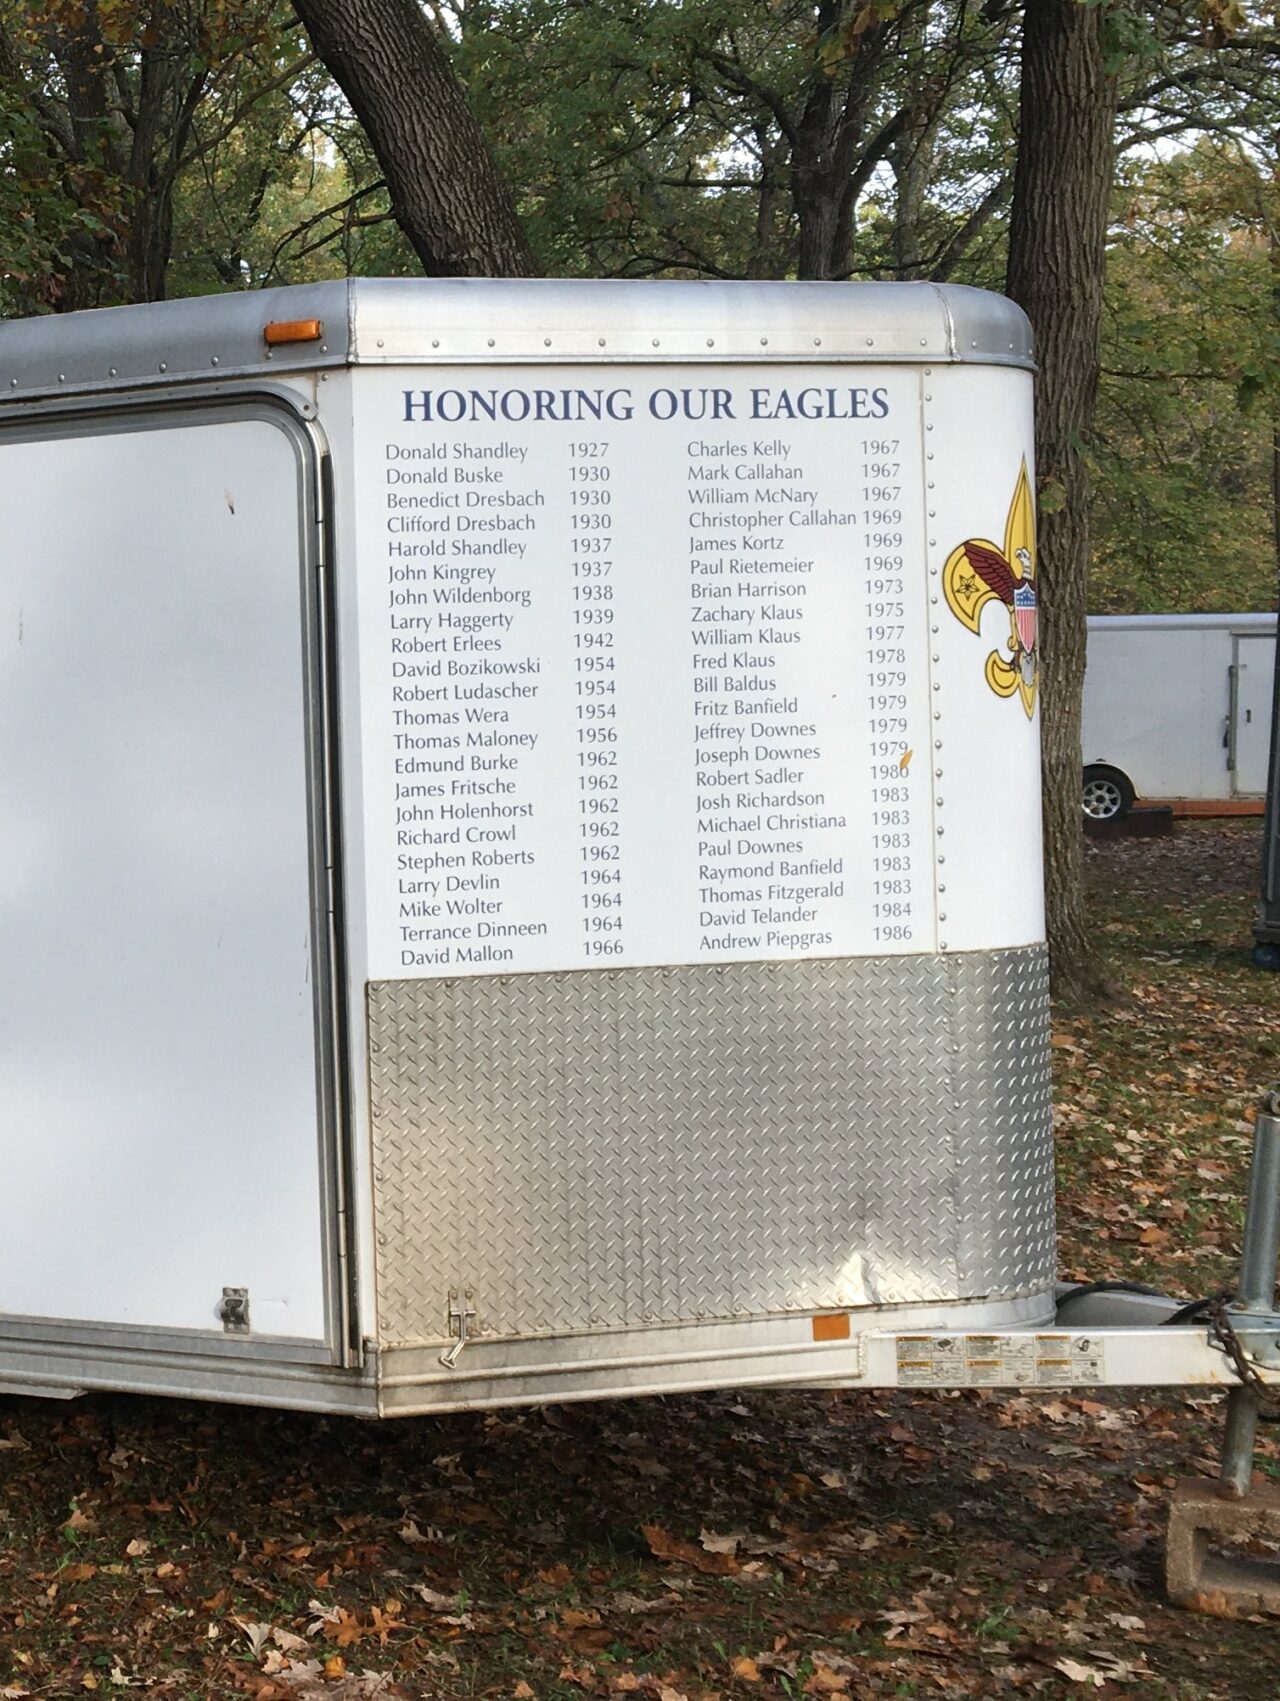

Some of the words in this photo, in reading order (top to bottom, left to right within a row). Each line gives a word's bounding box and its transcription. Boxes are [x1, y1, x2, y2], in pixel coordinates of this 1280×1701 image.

[401, 388, 635, 422] HONORING
[648, 388, 737, 421] OUR
[749, 387, 889, 420] EAGLES
[385, 442, 447, 461] Donald
[452, 441, 529, 464] Shandley
[568, 442, 610, 458] 1927
[687, 440, 748, 458] Charles
[753, 439, 791, 461] Kelly
[861, 439, 900, 455] 1967
[386, 466, 448, 485] Donald
[454, 465, 504, 484] Buske
[569, 465, 611, 482] 1930
[687, 463, 730, 481] Mark
[734, 463, 803, 481] Callahan
[862, 462, 901, 479] 1967
[387, 490, 460, 509] Benedict
[466, 489, 545, 508] Dresbach
[570, 489, 611, 506] 1930
[687, 487, 749, 505] William
[754, 487, 818, 508] McNary
[862, 486, 902, 502] 1967
[387, 514, 451, 534] Clifford
[456, 513, 536, 532] Dresbach
[570, 513, 612, 530] 1930
[688, 510, 785, 533] Christopher
[787, 509, 858, 527] Callahan
[863, 509, 902, 525] 1969
[388, 538, 446, 558] Harold
[451, 537, 527, 560] Shandley
[571, 537, 612, 554] 1937
[689, 536, 737, 555] James
[742, 535, 785, 551] Kortz
[864, 532, 903, 548] 1969
[388, 563, 427, 584] John
[433, 563, 497, 586] Kingrey
[571, 561, 613, 578] 1937
[690, 557, 724, 575] Paul
[729, 558, 815, 575] Rietemeier
[864, 555, 904, 572] 1969
[388, 587, 428, 609] John
[432, 585, 532, 608] Wildenborg
[572, 584, 614, 601] 1938
[691, 583, 732, 599] Brian
[737, 582, 807, 598] Harrison
[865, 578, 904, 594] 1973
[390, 613, 433, 634] Larry
[437, 612, 514, 634] Haggerty
[572, 608, 614, 625] 1939
[691, 604, 756, 626] Zachary
[760, 603, 803, 621] Klaus
[865, 602, 904, 618] 1975
[391, 635, 448, 654] Robert
[453, 634, 502, 652] Erlees
[573, 632, 614, 649] 1942
[691, 628, 753, 646] William
[758, 627, 801, 644] Klaus
[866, 625, 905, 641] 1977
[392, 659, 442, 678] David
[447, 656, 541, 676] Bozikowski
[574, 656, 616, 672] 1954
[693, 651, 728, 670] Fred
[733, 651, 776, 669] Klaus
[866, 648, 906, 664] 1978
[392, 684, 449, 702] Robert
[454, 681, 539, 700] Ludascher
[575, 679, 616, 697] 1954
[693, 675, 718, 693] Bill
[723, 674, 777, 692] Baldus
[867, 671, 907, 688] 1979
[392, 708, 460, 726] Thomas
[464, 707, 510, 724] Wera
[575, 703, 617, 720] 1954
[694, 700, 729, 717] Fritz
[734, 696, 798, 715] Banfield
[868, 694, 907, 711] 1979
[392, 732, 461, 750] Thomas
[466, 729, 539, 751] Maloney
[576, 726, 618, 744] 1956
[693, 722, 746, 744] Jeffrey
[750, 722, 817, 738] Downes
[869, 717, 908, 734] 1979
[394, 754, 465, 775] Edmund
[470, 753, 519, 771] Burke
[577, 750, 618, 767] 1962
[694, 745, 749, 768] Joseph
[754, 745, 821, 761] Downes
[869, 740, 910, 757] 1979
[394, 782, 446, 802] James
[451, 777, 516, 796] Fritsche
[578, 774, 619, 791] 1962
[696, 769, 750, 787] Robert
[754, 767, 805, 785] Sadler
[395, 804, 435, 826] John
[440, 800, 534, 820] Holenhorst
[578, 797, 619, 815] 1962
[695, 792, 731, 814] Josh
[736, 789, 825, 809] Richardson
[871, 786, 910, 803] 1983
[697, 814, 761, 833] Michael
[766, 813, 847, 831] Christiana
[872, 809, 910, 826] 1983
[397, 826, 461, 846] Richard
[465, 823, 516, 843] Crowl
[579, 821, 620, 838] 1962
[698, 839, 732, 857] Paul
[737, 839, 804, 855] Downes
[872, 832, 911, 849] 1983
[397, 851, 466, 875] Stephen
[471, 848, 535, 867] Roberts
[580, 844, 621, 862] 1962
[699, 860, 774, 885] Raymond
[779, 857, 843, 877] Banfield
[873, 855, 911, 872] 1983
[398, 878, 441, 898] Larry
[446, 873, 500, 892] Devlin
[581, 868, 622, 885] 1964
[698, 886, 763, 904] Thomas
[768, 880, 844, 905] Fitzgerald
[873, 878, 912, 895] 1983
[399, 899, 442, 918] Mike
[445, 897, 503, 916] Wolter
[581, 892, 623, 909] 1964
[699, 908, 746, 928] David
[750, 905, 818, 925] Telander
[872, 902, 912, 918] 1984
[399, 925, 472, 942] Terrance
[477, 921, 548, 938] Dinneen
[582, 915, 623, 933] 1964
[699, 932, 762, 951] Andrew
[766, 930, 833, 951] Piepgras
[872, 925, 913, 941] 1986
[401, 946, 450, 966] David
[455, 944, 514, 963] Mallon
[583, 939, 624, 956] 1966
